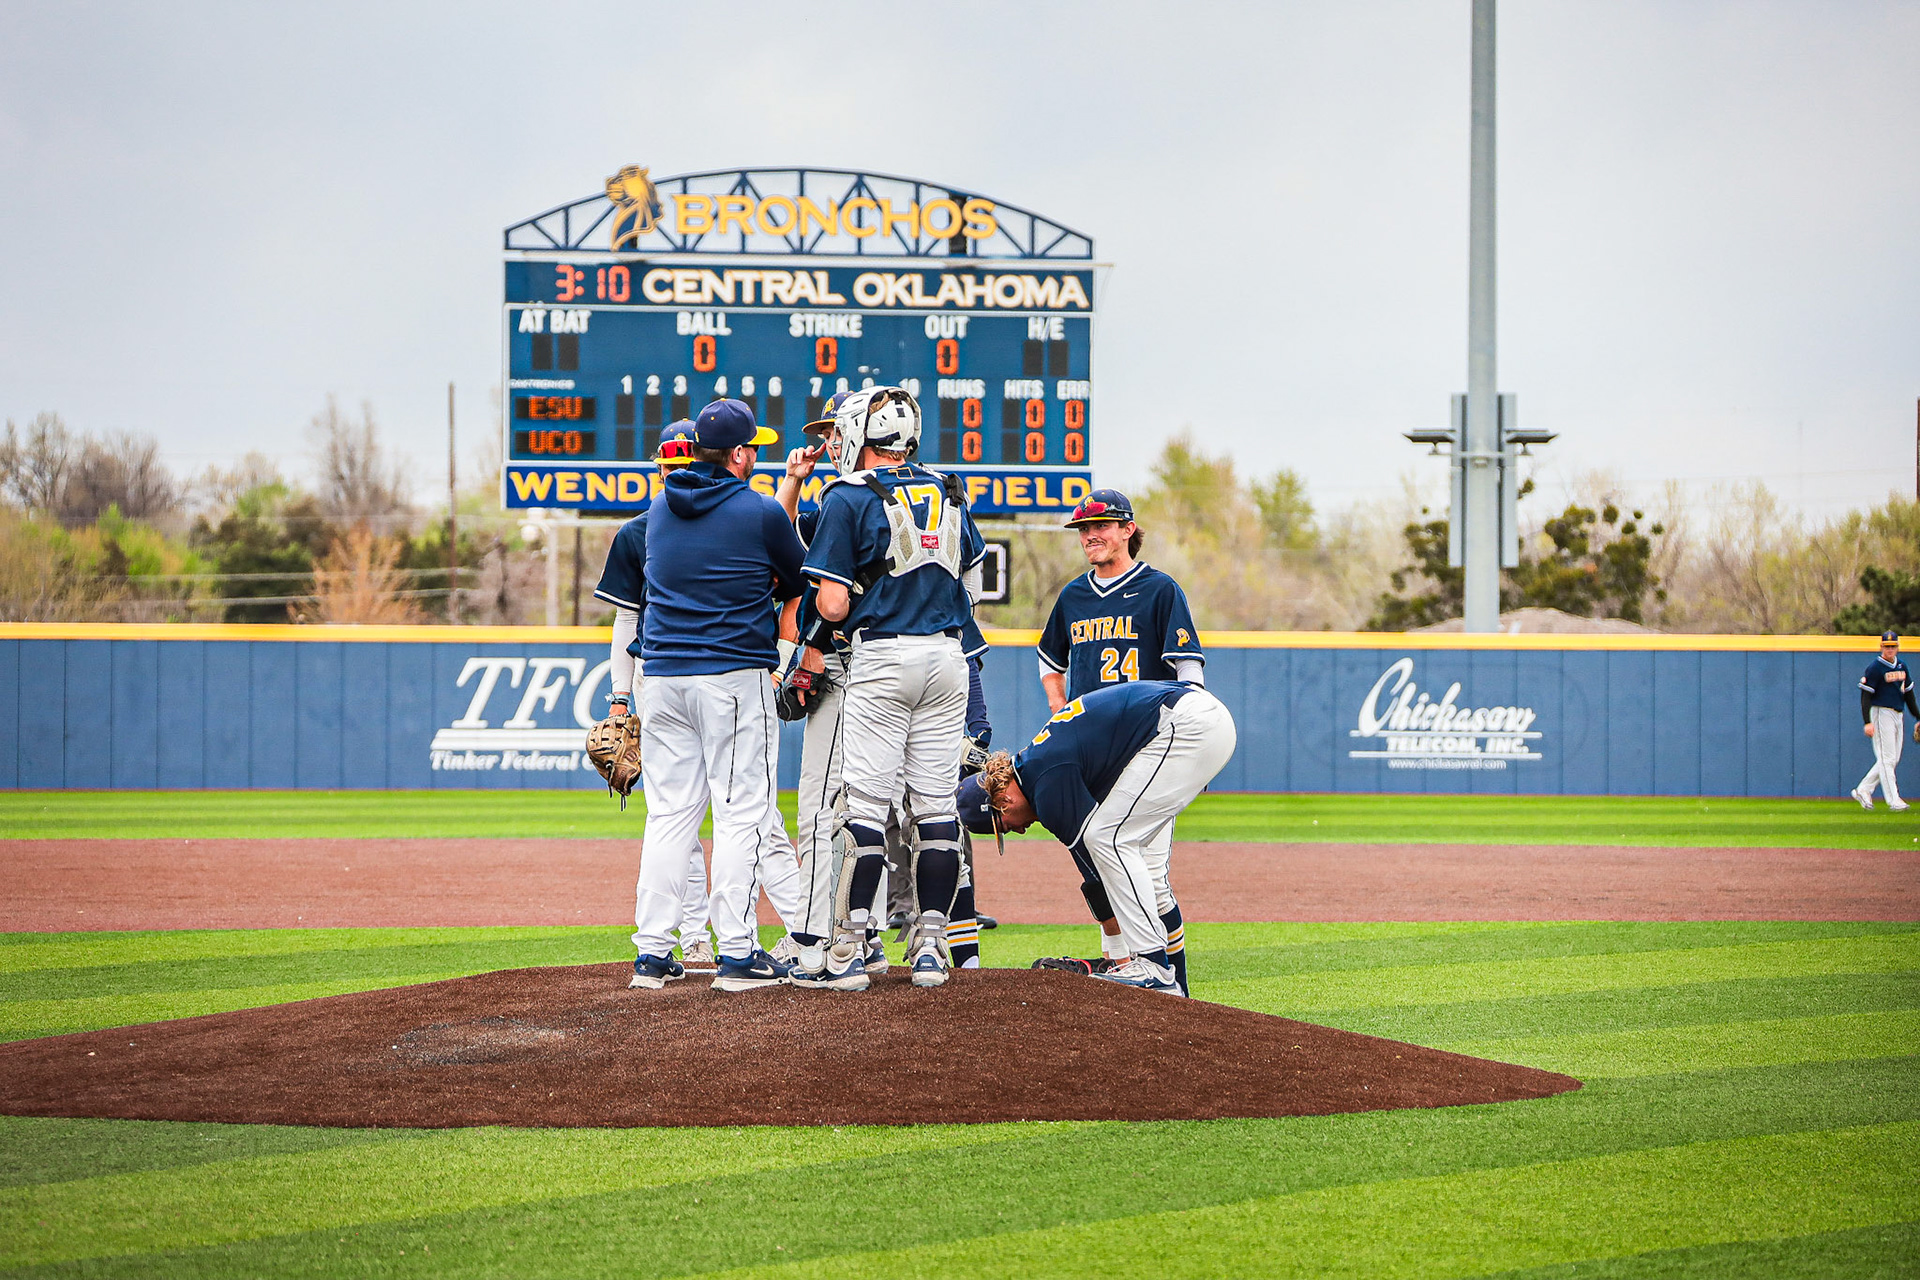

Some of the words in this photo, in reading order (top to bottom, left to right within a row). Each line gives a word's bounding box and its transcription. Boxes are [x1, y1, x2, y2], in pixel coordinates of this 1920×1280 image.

[672, 194, 998, 239] BRONCHOS
[555, 265, 631, 302] 3:10
[642, 268, 847, 305] CENTRAL
[853, 272, 1090, 308] OKLAHOMA
[518, 309, 546, 333] AT
[550, 309, 592, 333] BAT
[676, 311, 732, 336] BALL
[789, 313, 863, 338] STRIKE
[924, 315, 970, 339] OUT
[1027, 316, 1065, 341] H/E
[693, 335, 716, 372] 0
[815, 337, 838, 373] 0
[936, 339, 959, 374] 0
[621, 375, 632, 395] 1
[646, 375, 661, 396] 2
[673, 375, 688, 396] 3
[714, 375, 728, 396] 4
[741, 376, 756, 397] 5
[768, 376, 783, 397] 6
[809, 377, 823, 398] 7
[899, 379, 921, 398] 10
[937, 378, 986, 400] RUNS
[1004, 379, 1044, 400] HITS
[528, 396, 583, 420] ESU
[962, 398, 982, 428] 0
[1025, 399, 1045, 429] 0
[1064, 400, 1084, 429] 0
[528, 430, 583, 455] UCO
[962, 431, 982, 462] 0
[1025, 432, 1045, 462] 0
[1064, 432, 1084, 463] 0
[965, 476, 1091, 506] FIELD
[892, 484, 942, 532] 17
[1070, 616, 1139, 645] CENTRAL
[1100, 647, 1140, 683] 24
[1358, 657, 1537, 737] Chickasaw
[1486, 737, 1529, 754] INC.
[429, 751, 499, 771] Tinker
[501, 751, 580, 771] Federal
